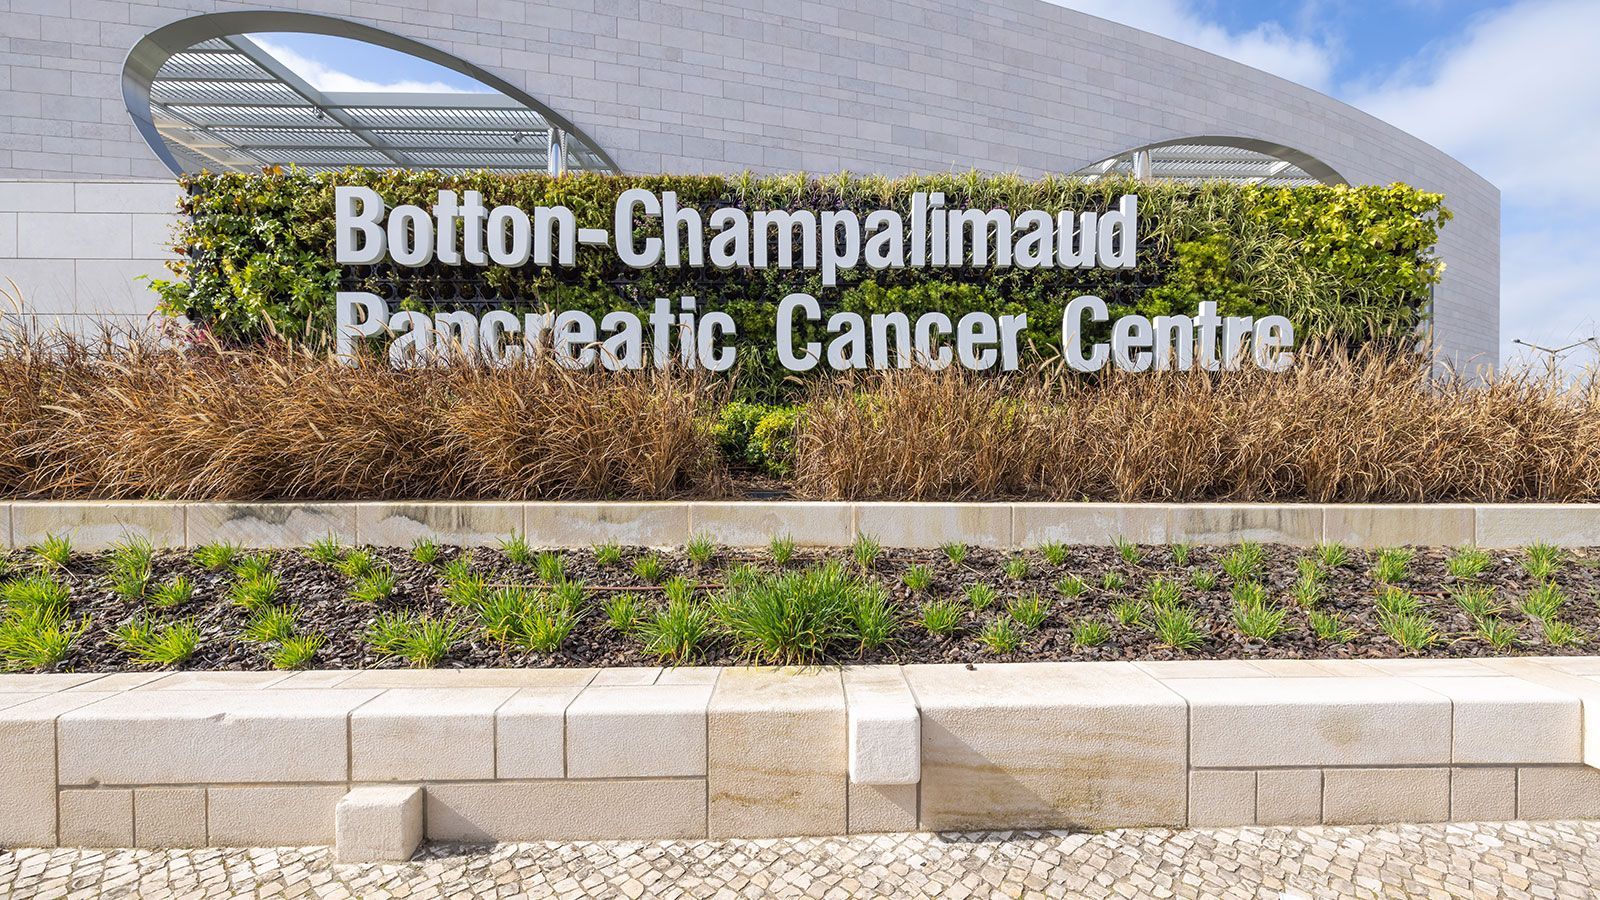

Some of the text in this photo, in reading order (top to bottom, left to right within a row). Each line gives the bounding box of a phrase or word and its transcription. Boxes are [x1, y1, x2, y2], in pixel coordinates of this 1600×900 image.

[335, 186, 1137, 288] Botton-Champalimaud
[336, 292, 1295, 373] Pancreatic Cancer Centre
